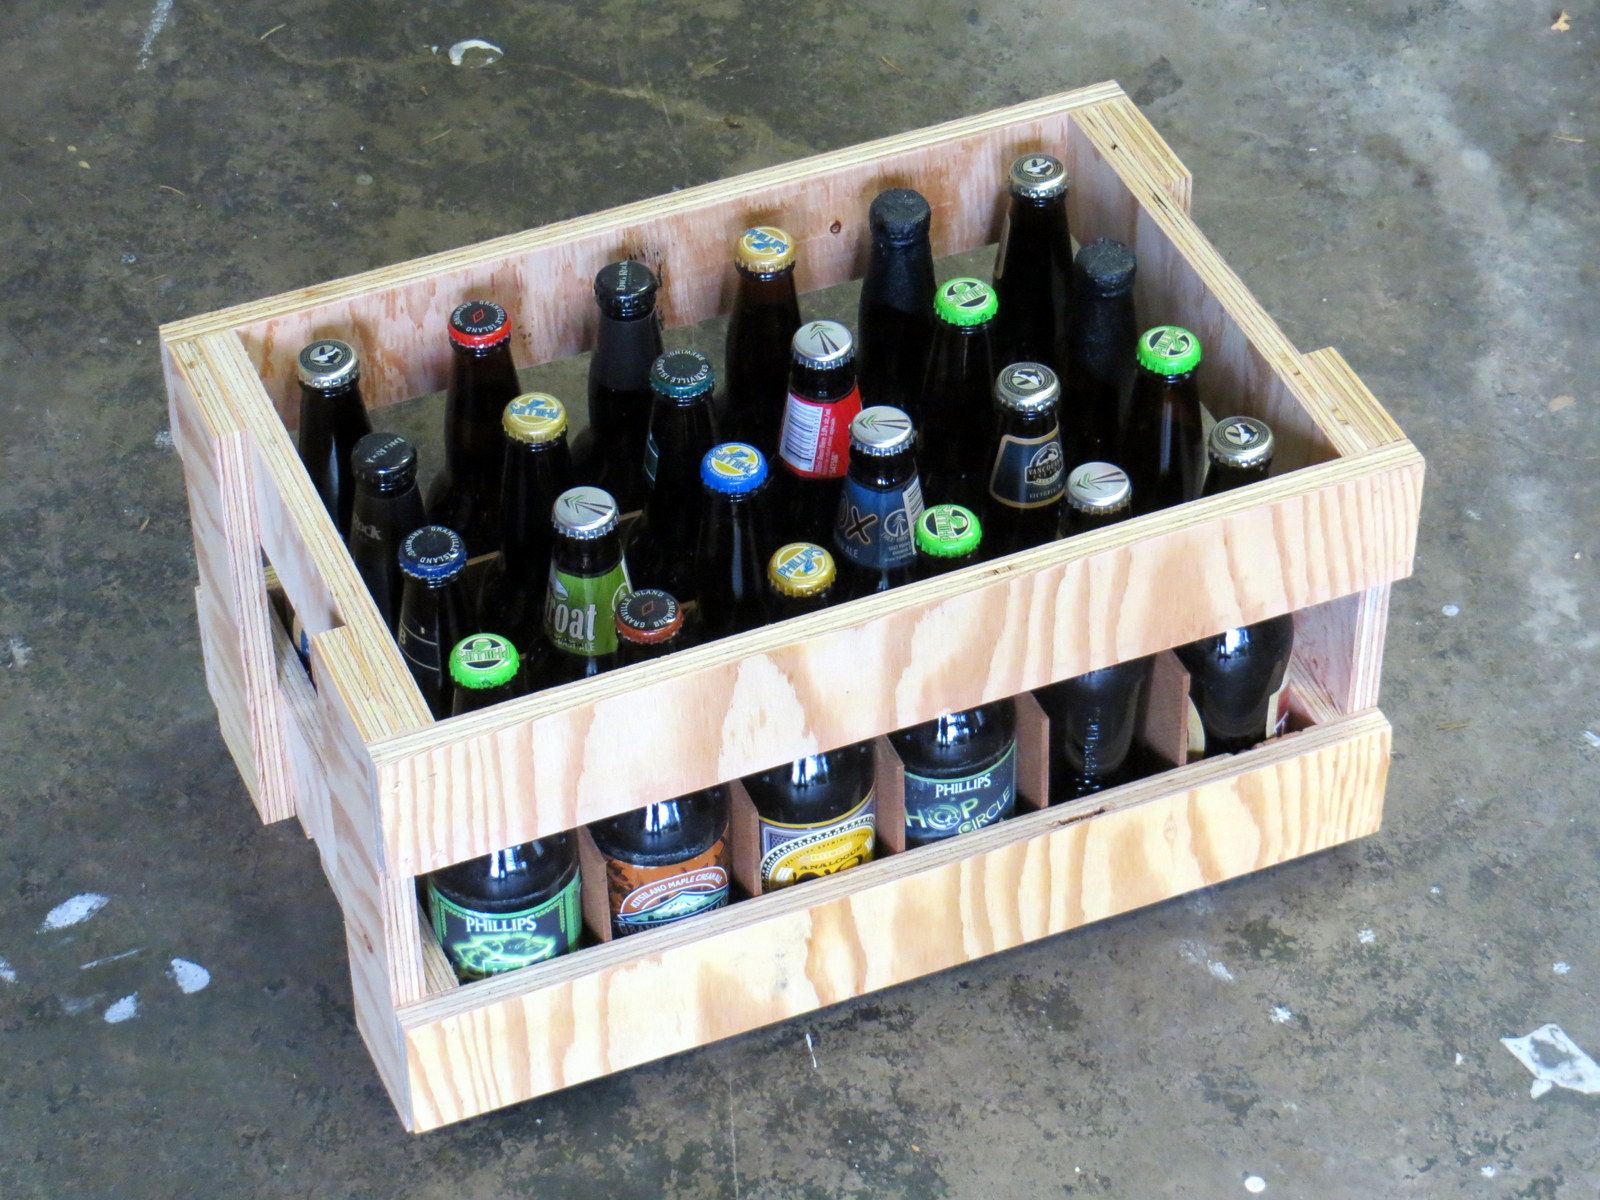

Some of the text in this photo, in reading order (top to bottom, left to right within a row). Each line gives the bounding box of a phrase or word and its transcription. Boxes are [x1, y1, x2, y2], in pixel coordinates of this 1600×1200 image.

[465, 322, 498, 333] ISLAND
[656, 358, 670, 380] ISLAND
[671, 364, 709, 384] GRANVILLE
[430, 526, 459, 554] GRANVILLE
[420, 551, 454, 564] ISLAND
[620, 589, 676, 628] GRANVILLE ISLAND BREWING
[935, 772, 991, 798] PHILLIPS
[904, 797, 979, 831] HOP
[957, 785, 1010, 834] CIRCLE
[668, 875, 695, 889] MAPLE
[466, 914, 537, 932] PHILLIPS
